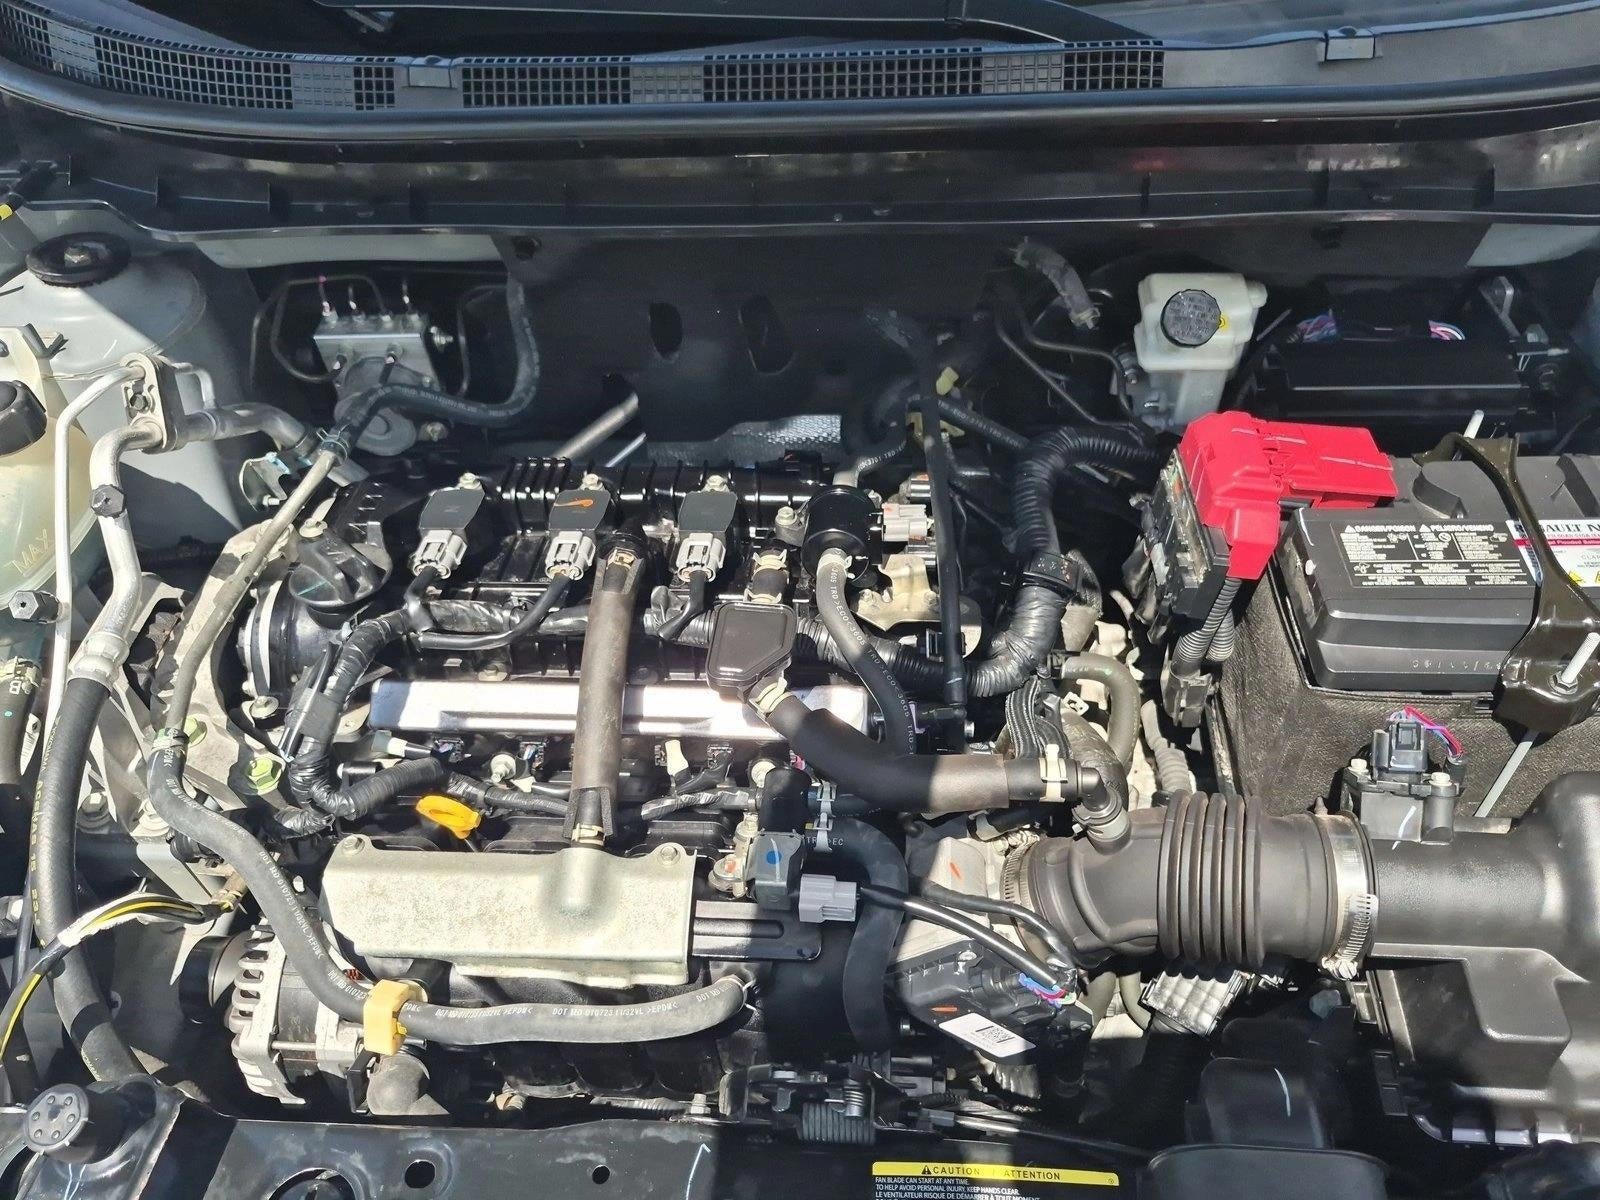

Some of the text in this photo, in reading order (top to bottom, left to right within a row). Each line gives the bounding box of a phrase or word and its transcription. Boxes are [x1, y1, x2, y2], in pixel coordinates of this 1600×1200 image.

[933, 1166, 980, 1175] CAUTION
[1003, 1169, 1061, 1180] ATTENTION
[918, 1177, 934, 1185] START
[883, 1191, 923, 1199] VENTILATEUR
